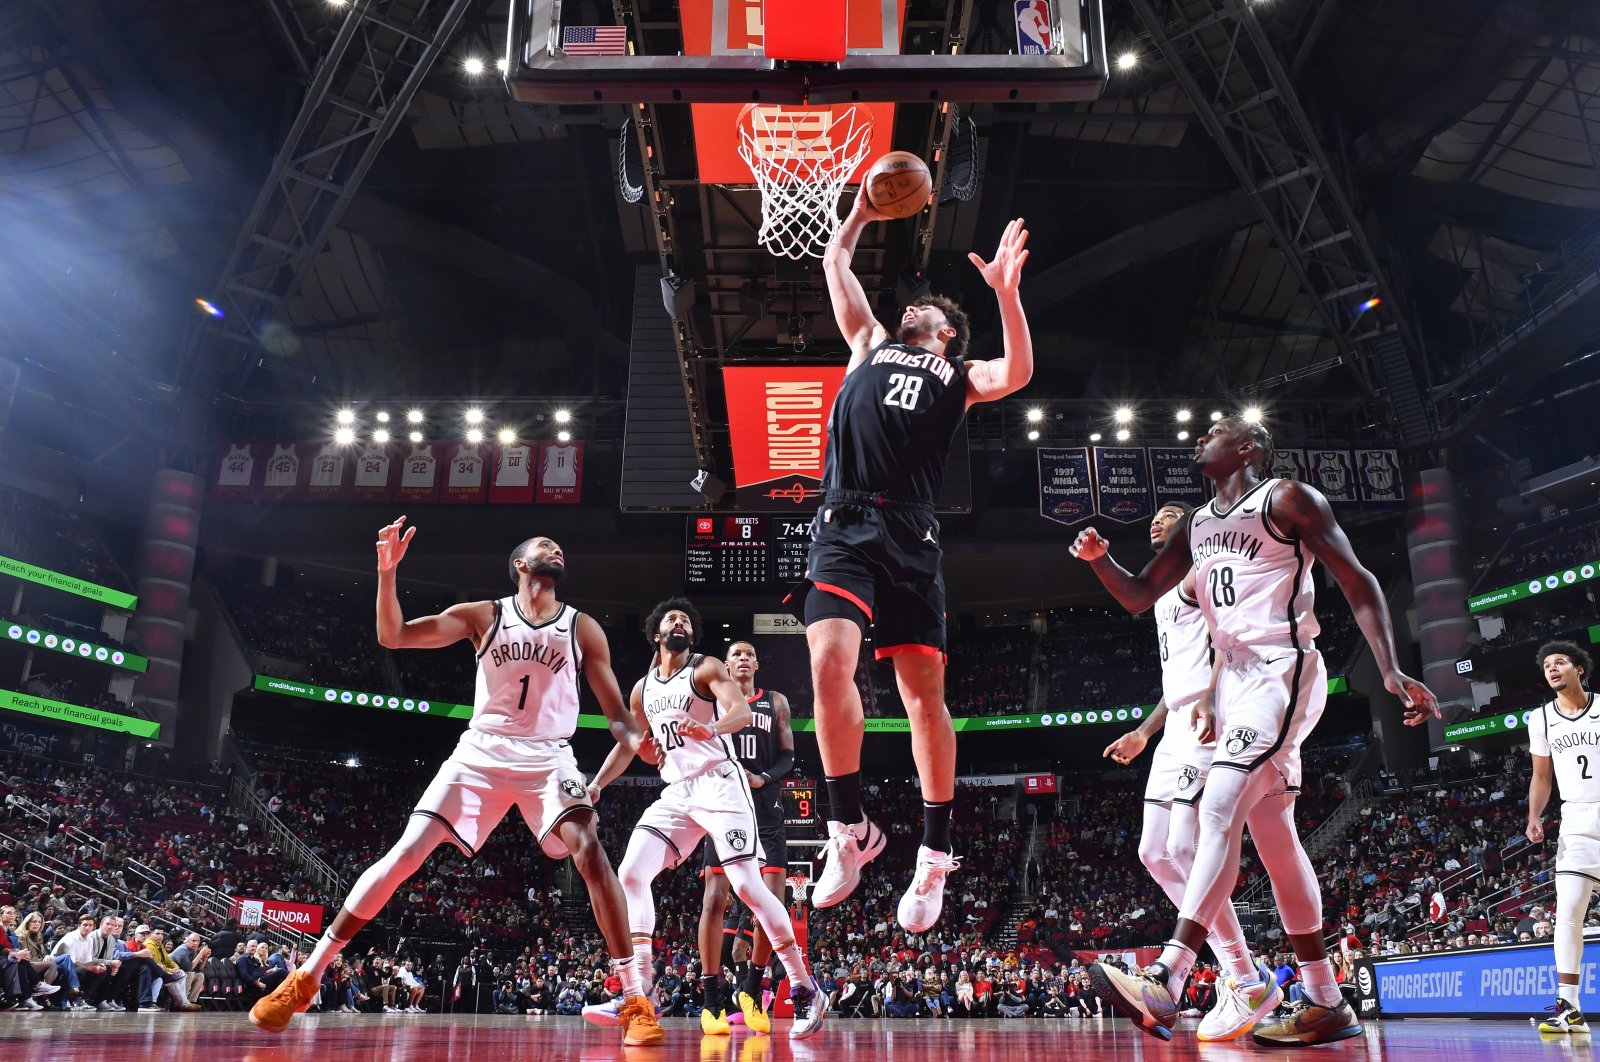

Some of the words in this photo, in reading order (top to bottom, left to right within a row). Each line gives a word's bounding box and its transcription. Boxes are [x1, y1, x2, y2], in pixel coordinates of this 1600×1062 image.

[1024, 45, 1040, 54] NBA
[871, 348, 954, 386] HOUSTON
[883, 374, 924, 410] 28
[766, 382, 823, 470] HOUSTON
[228, 462, 244, 472] 44
[276, 462, 290, 472] 45
[321, 462, 334, 472] 23
[365, 462, 380, 472] 24
[412, 462, 426, 474] 22
[458, 462, 474, 474] 34
[558, 456, 564, 468] 11
[1054, 468, 1074, 476] 1997
[1111, 467, 1133, 475] 1998
[1052, 476, 1079, 484] WNBA
[1164, 476, 1192, 484] WNBA
[1043, 486, 1089, 496] Champions
[1100, 485, 1147, 495] Champions
[1156, 486, 1202, 495] Champions
[742, 525, 752, 538] 8
[782, 523, 812, 536] 7:47
[1194, 531, 1264, 570] BROOKLYN
[0, 560, 26, 574] Reach
[28, 568, 46, 580] your
[48, 574, 81, 590] financial
[82, 585, 103, 597] goals
[1210, 566, 1236, 608] 28
[1470, 592, 1508, 608] creditkarma
[774, 618, 798, 626] SKY
[490, 642, 568, 674] BROOKLYN
[268, 681, 306, 694] creditkarma
[518, 674, 530, 710] 1
[12, 696, 40, 710] Reach
[42, 705, 62, 716] your
[64, 707, 100, 722] financial
[100, 716, 124, 728] goals
[646, 694, 694, 722] BROOKLYN
[986, 718, 1022, 726] creditkarma
[1228, 728, 1254, 742] NETS
[1446, 724, 1486, 737] creditkarma
[739, 734, 756, 759] 10
[1576, 754, 1592, 780] 2
[792, 790, 812, 799] 7:47
[799, 800, 809, 817] 9
[727, 830, 746, 841] NETS
[266, 908, 310, 924] TUNDRA
[1381, 971, 1462, 999] PROGRESSIVE
[1362, 998, 1376, 1012] AT&T
